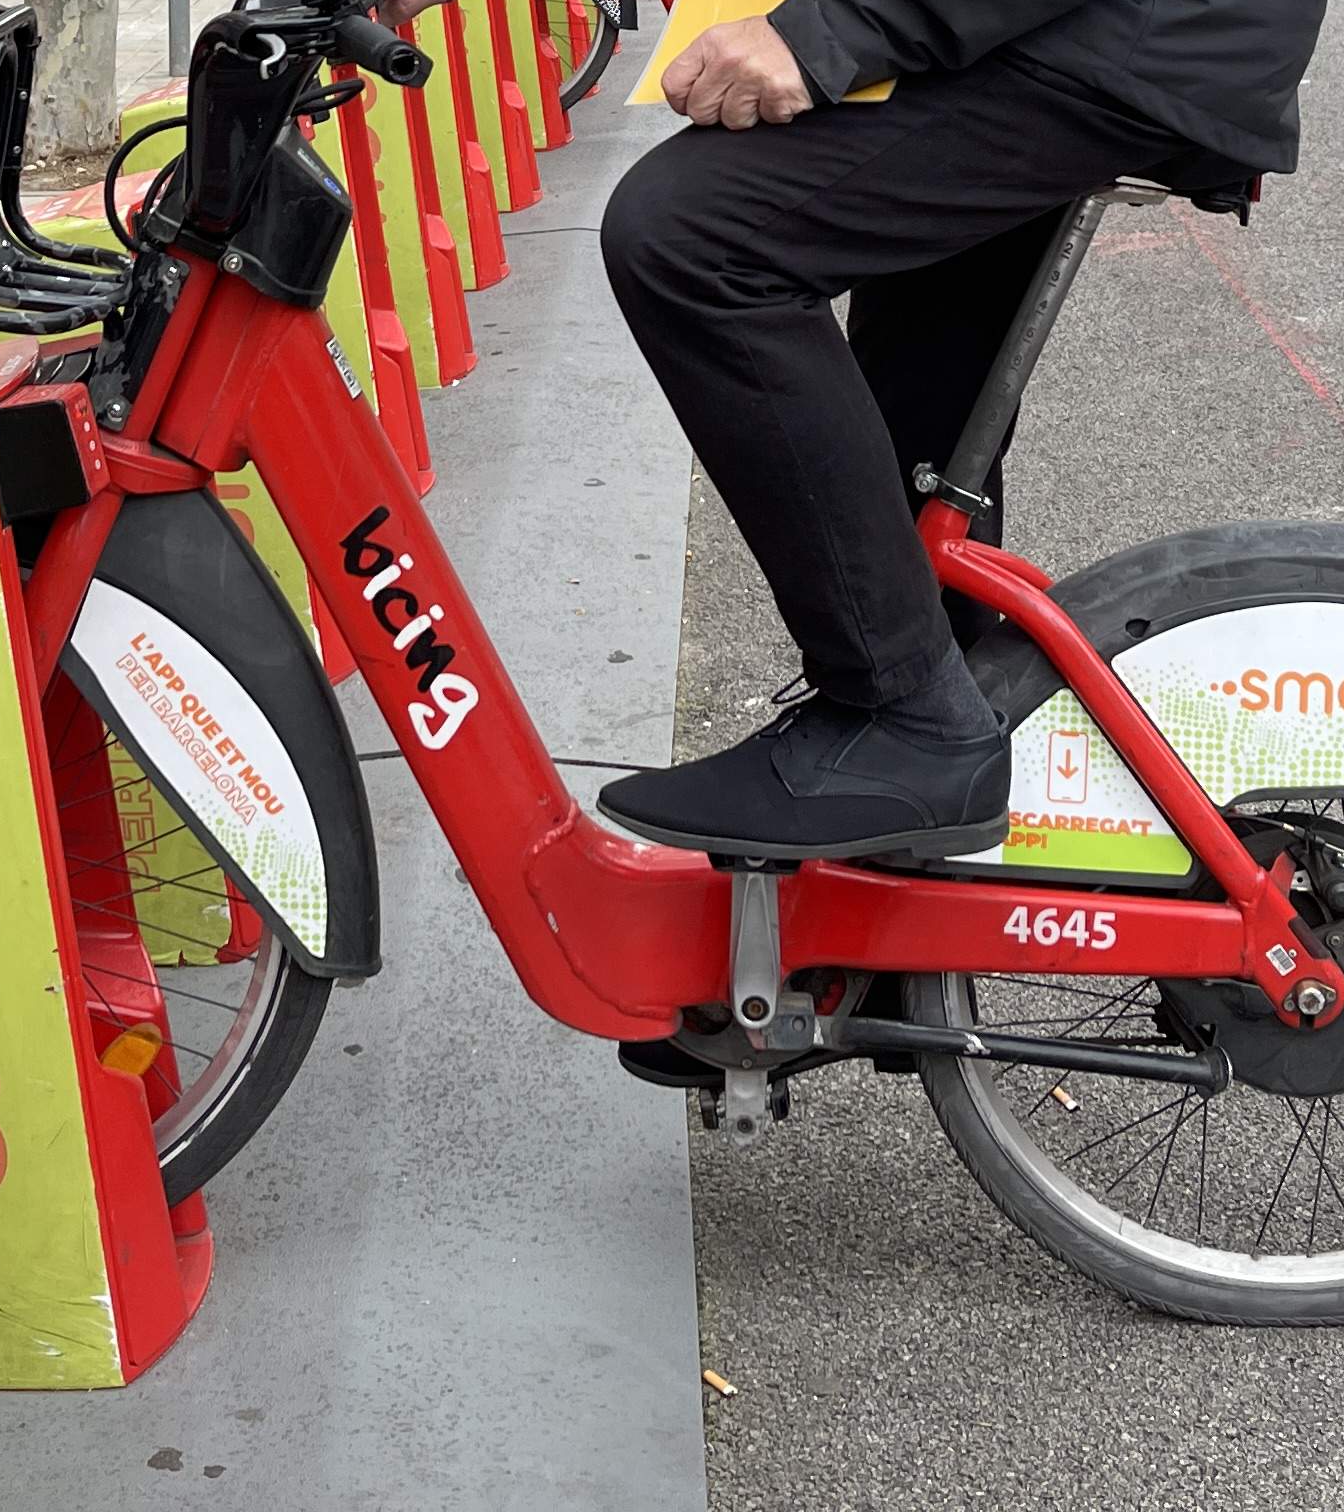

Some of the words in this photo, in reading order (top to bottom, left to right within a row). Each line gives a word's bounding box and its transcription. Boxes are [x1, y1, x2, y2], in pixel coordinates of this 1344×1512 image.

[339, 505, 479, 750] bicing
[116, 653, 158, 700] PER
[151, 695, 257, 826] BARCELONA
[131, 632, 185, 693] L'APP
[180, 694, 223, 740] QUE
[215, 737, 246, 766] ET
[239, 765, 285, 815] MOU
[1003, 905, 1118, 950] 4645
